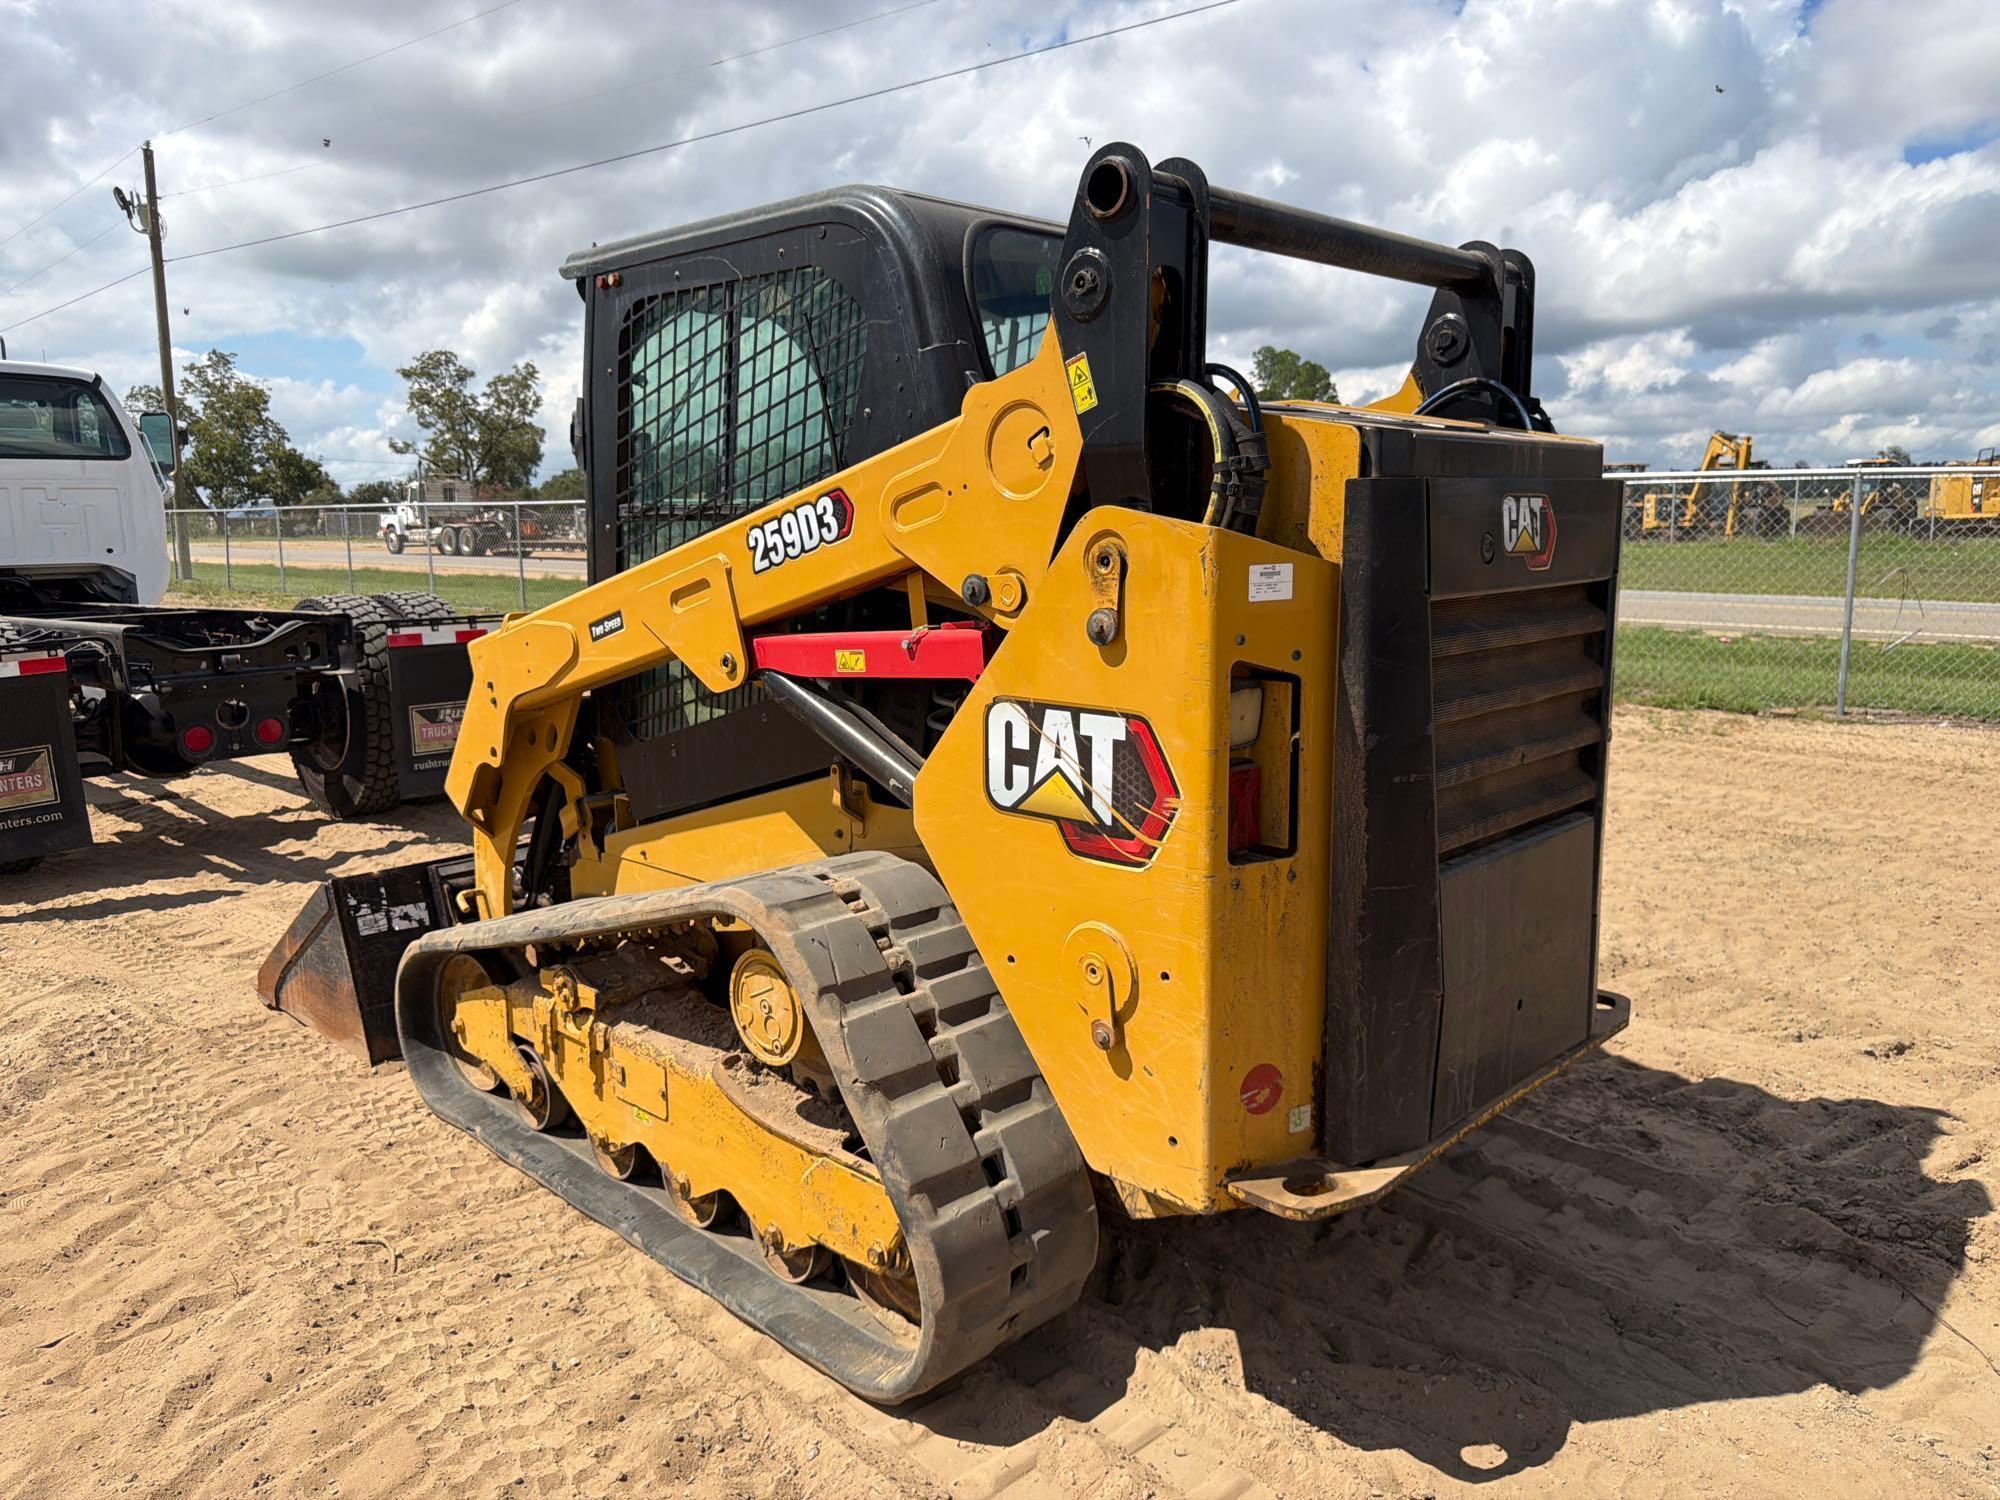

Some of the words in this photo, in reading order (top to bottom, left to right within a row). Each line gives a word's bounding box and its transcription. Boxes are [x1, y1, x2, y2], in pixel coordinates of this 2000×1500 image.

[748, 496, 838, 573] 259D3
[1502, 496, 1543, 552] CAT
[421, 725, 454, 739] TRUCK
[988, 701, 1126, 826] CAT
[0, 773, 42, 793] NTERS
[0, 811, 63, 830] nters.com
